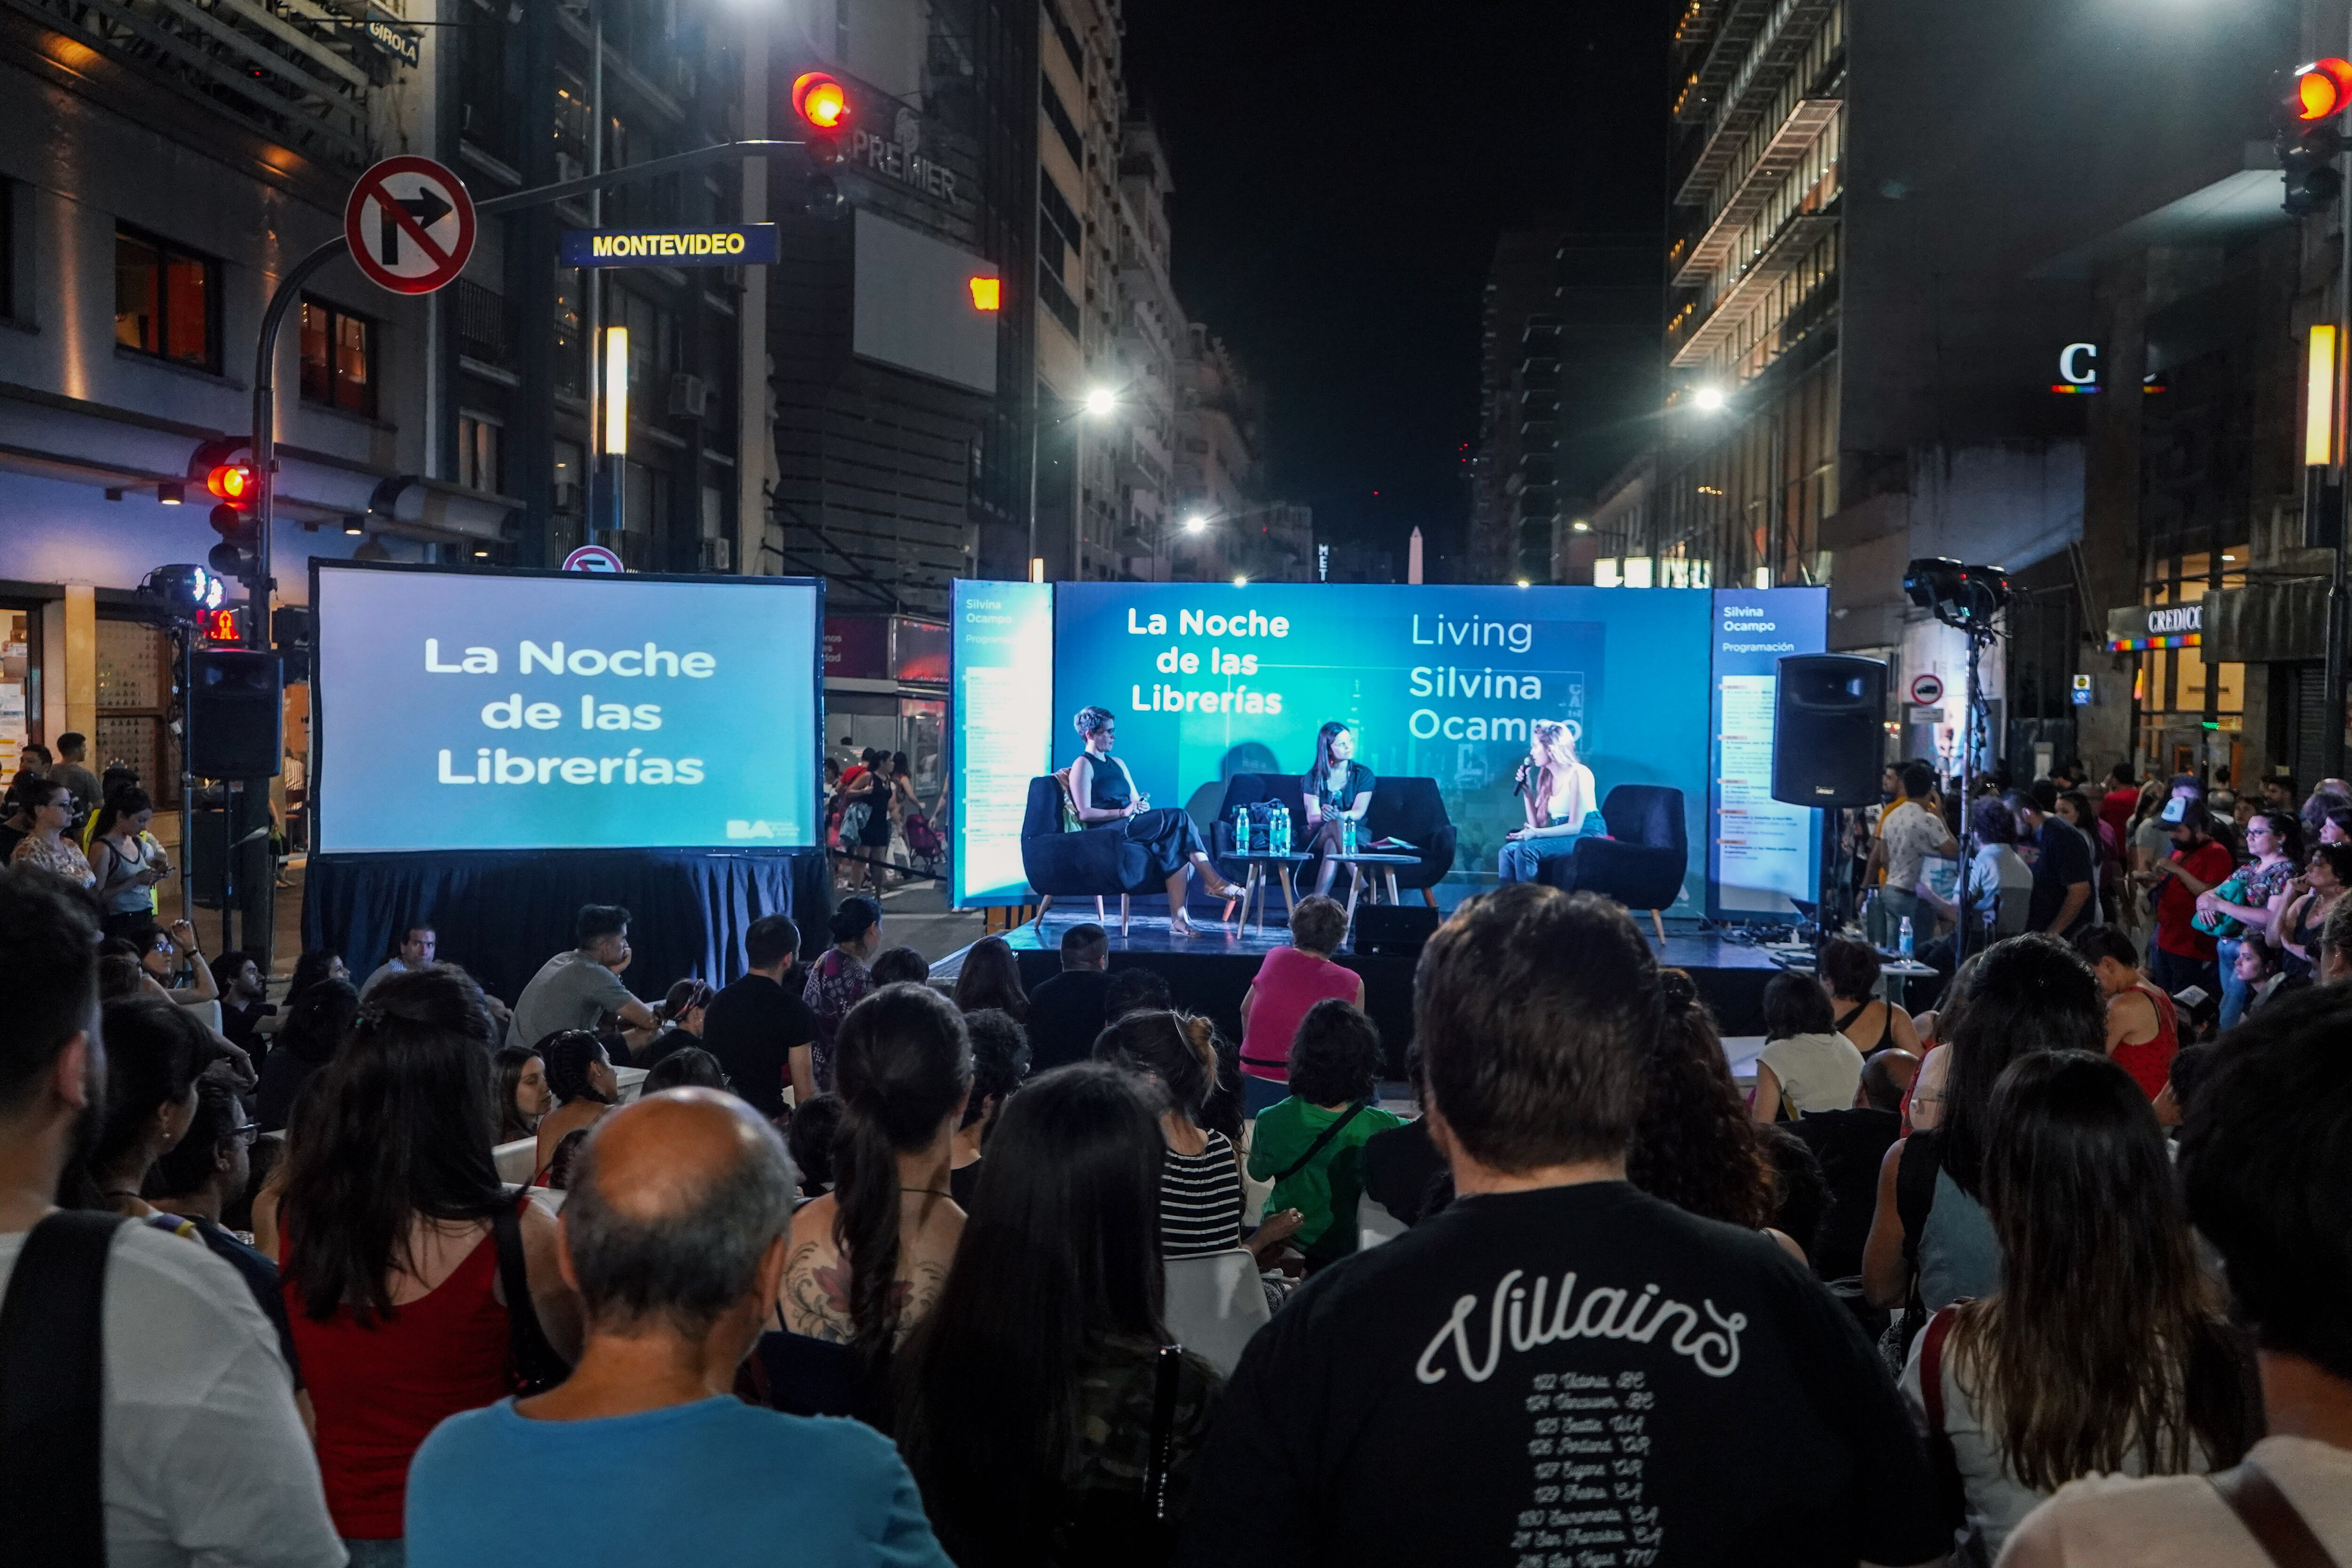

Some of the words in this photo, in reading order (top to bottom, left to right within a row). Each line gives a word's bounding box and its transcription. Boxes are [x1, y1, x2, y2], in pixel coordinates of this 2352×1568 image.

[370, 22, 416, 61] GIROLA
[852, 129, 956, 204] PREMIER
[593, 232, 745, 257] MONTEVIDEO
[2060, 343, 2097, 383] C
[966, 599, 1001, 610] Silvina
[966, 613, 1012, 625] Ocampo
[1724, 606, 1764, 617] Silvina
[1128, 608, 1167, 635] La
[1179, 609, 1289, 638] Noche
[1413, 614, 1532, 653] Living
[1724, 620, 1776, 633] Ocampo
[425, 638, 498, 673] La
[519, 640, 716, 678] Noche
[1156, 646, 1200, 674] de
[1211, 647, 1259, 675] las
[1722, 642, 1795, 654] Programación
[1132, 683, 1282, 714] Librerías
[1409, 666, 1542, 700] Silvina
[481, 693, 562, 730] de
[581, 695, 662, 730] las
[438, 747, 704, 784] Librerías
[1415, 1269, 1748, 1384] Villains
